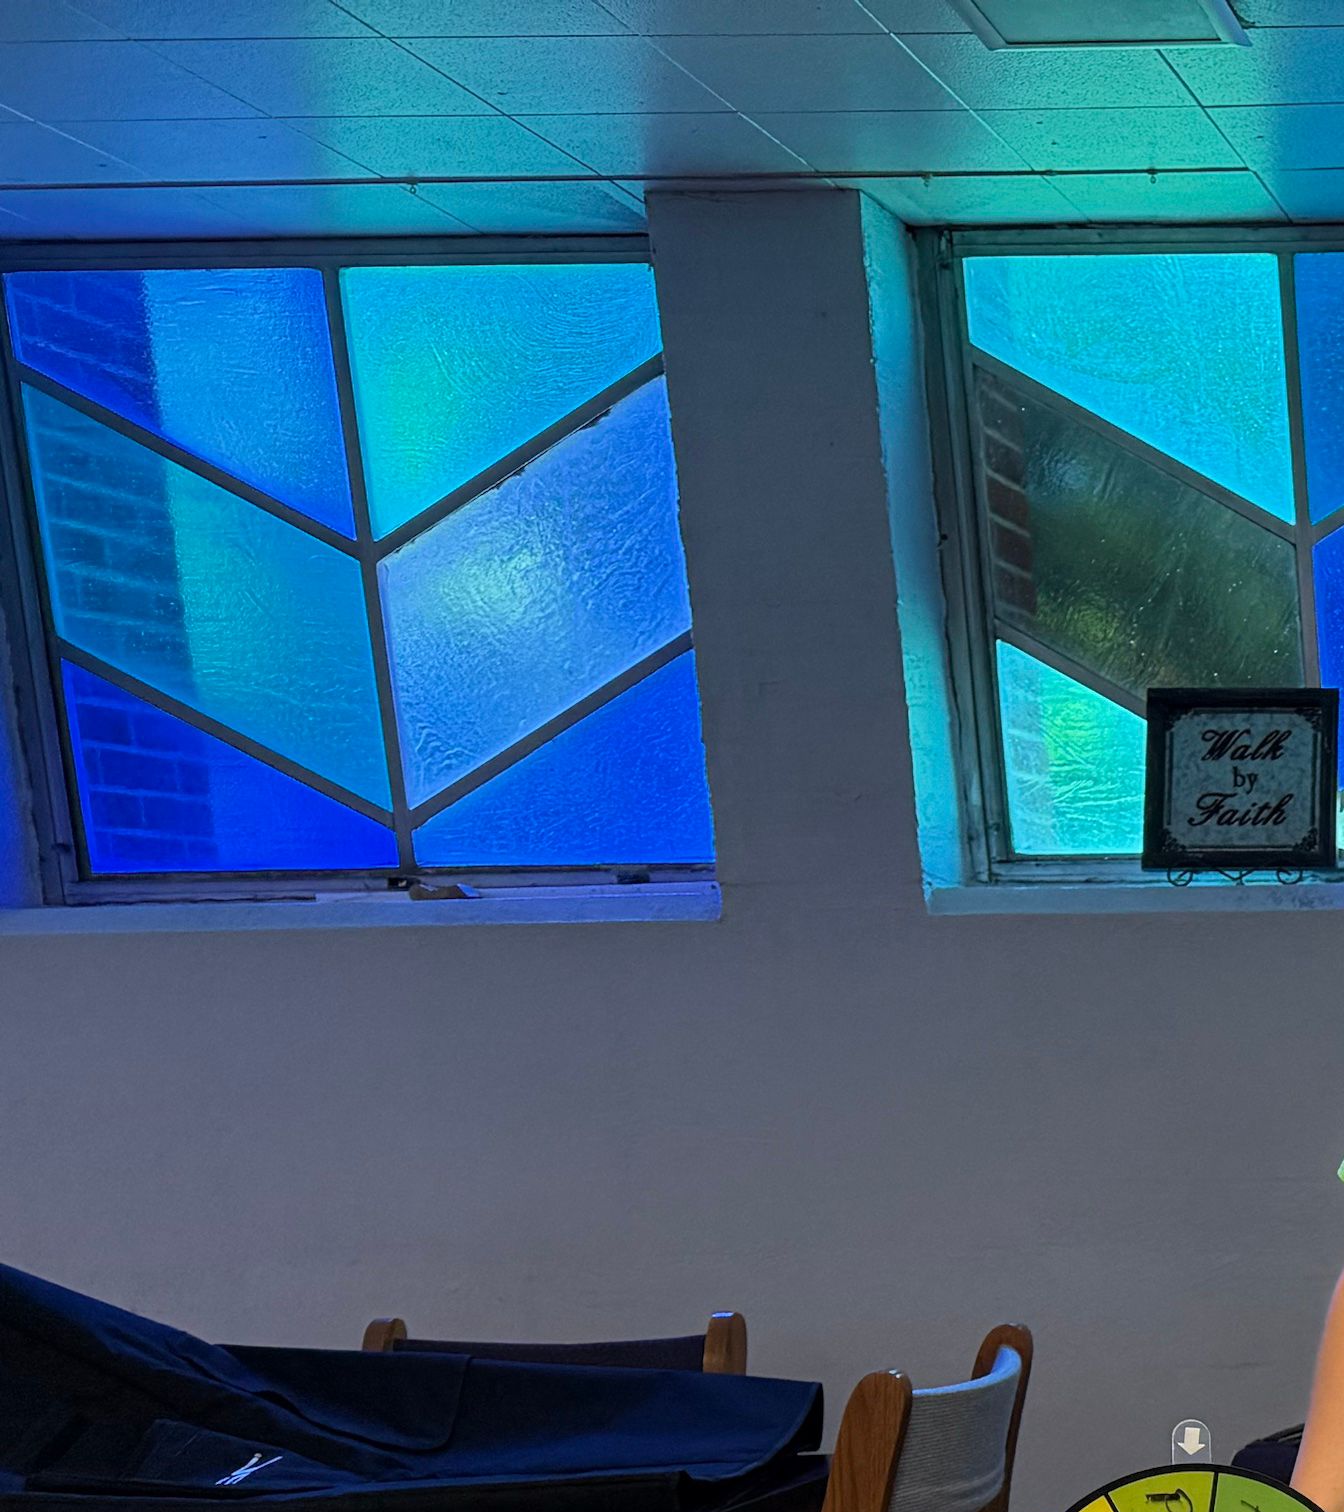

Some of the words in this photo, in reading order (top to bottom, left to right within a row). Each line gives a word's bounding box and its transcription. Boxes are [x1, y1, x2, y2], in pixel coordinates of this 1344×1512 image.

[1200, 729, 1292, 762] Walk
[1233, 766, 1258, 794] by
[1187, 792, 1294, 826] Faith
